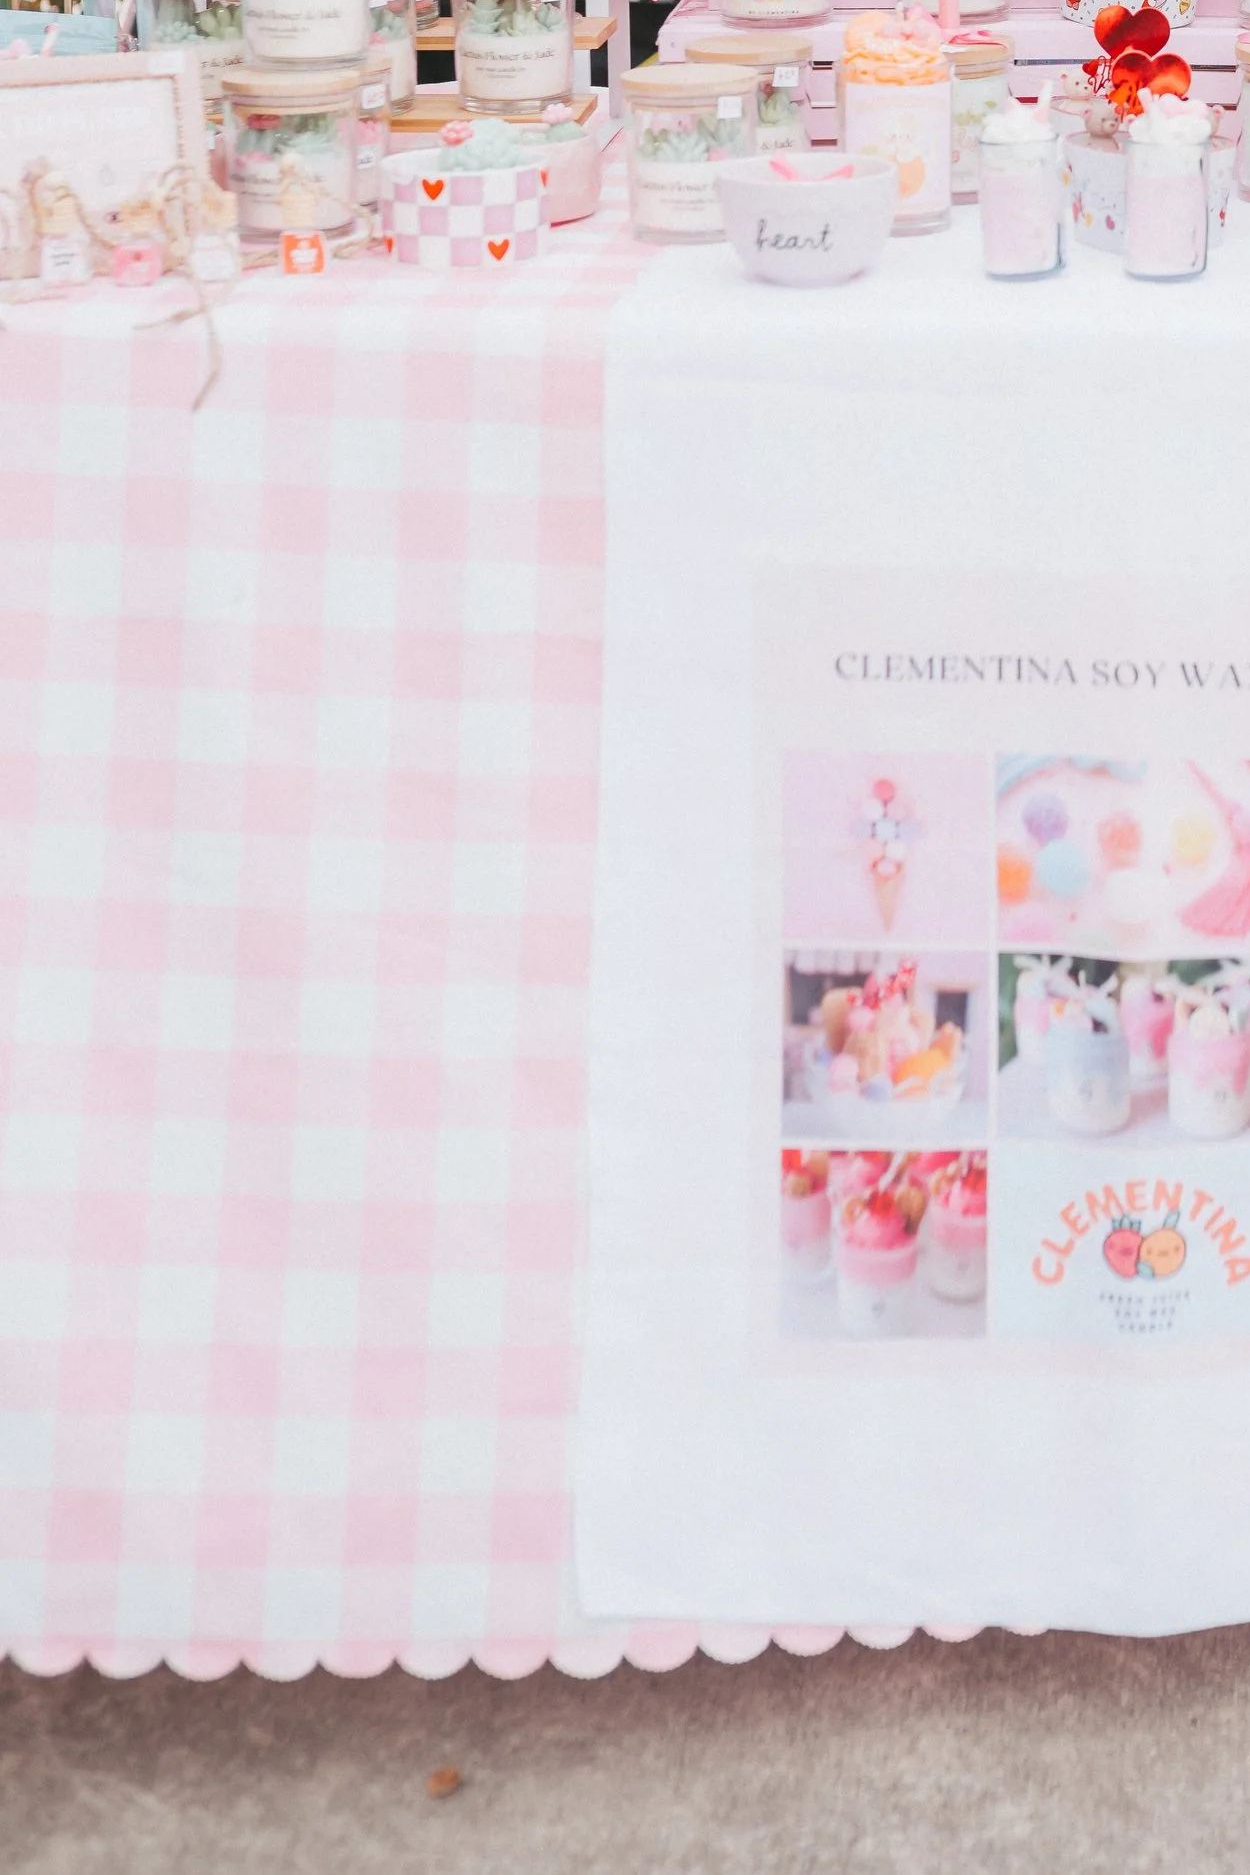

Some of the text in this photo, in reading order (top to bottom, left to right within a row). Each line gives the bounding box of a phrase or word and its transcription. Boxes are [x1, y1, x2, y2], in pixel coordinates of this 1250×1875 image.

[756, 219, 834, 252] heart
[835, 651, 1078, 685] CLEMENTINA
[1092, 657, 1168, 689] SOY
